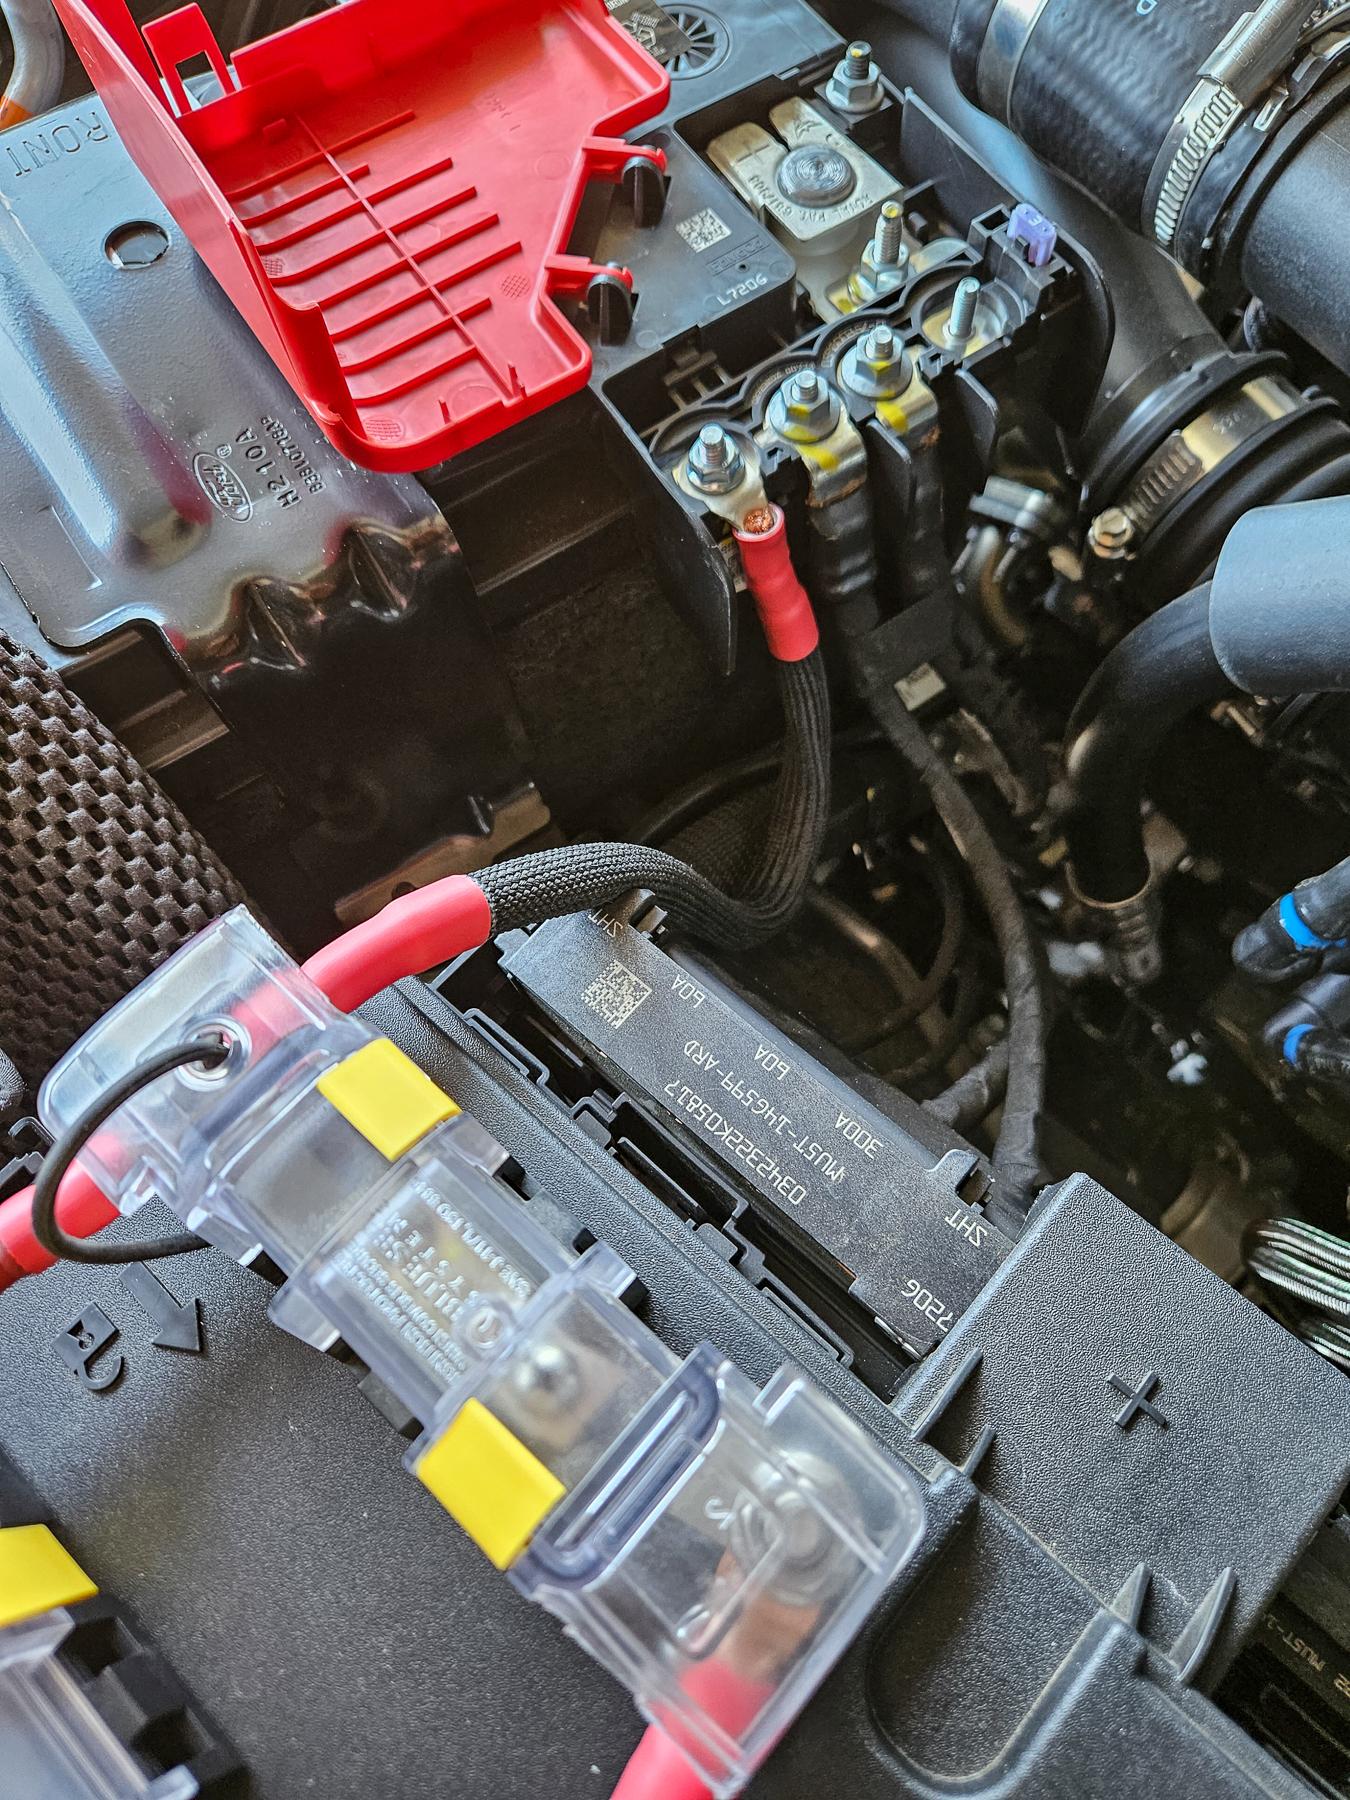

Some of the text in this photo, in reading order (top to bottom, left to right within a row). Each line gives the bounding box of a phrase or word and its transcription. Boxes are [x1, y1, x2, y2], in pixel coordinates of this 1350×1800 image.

[586, 903, 625, 940] SHT
[669, 973, 707, 1008] 60A
[751, 1042, 791, 1080] 60A
[831, 1109, 884, 1159] 300A
[943, 1204, 990, 1248] SHT
